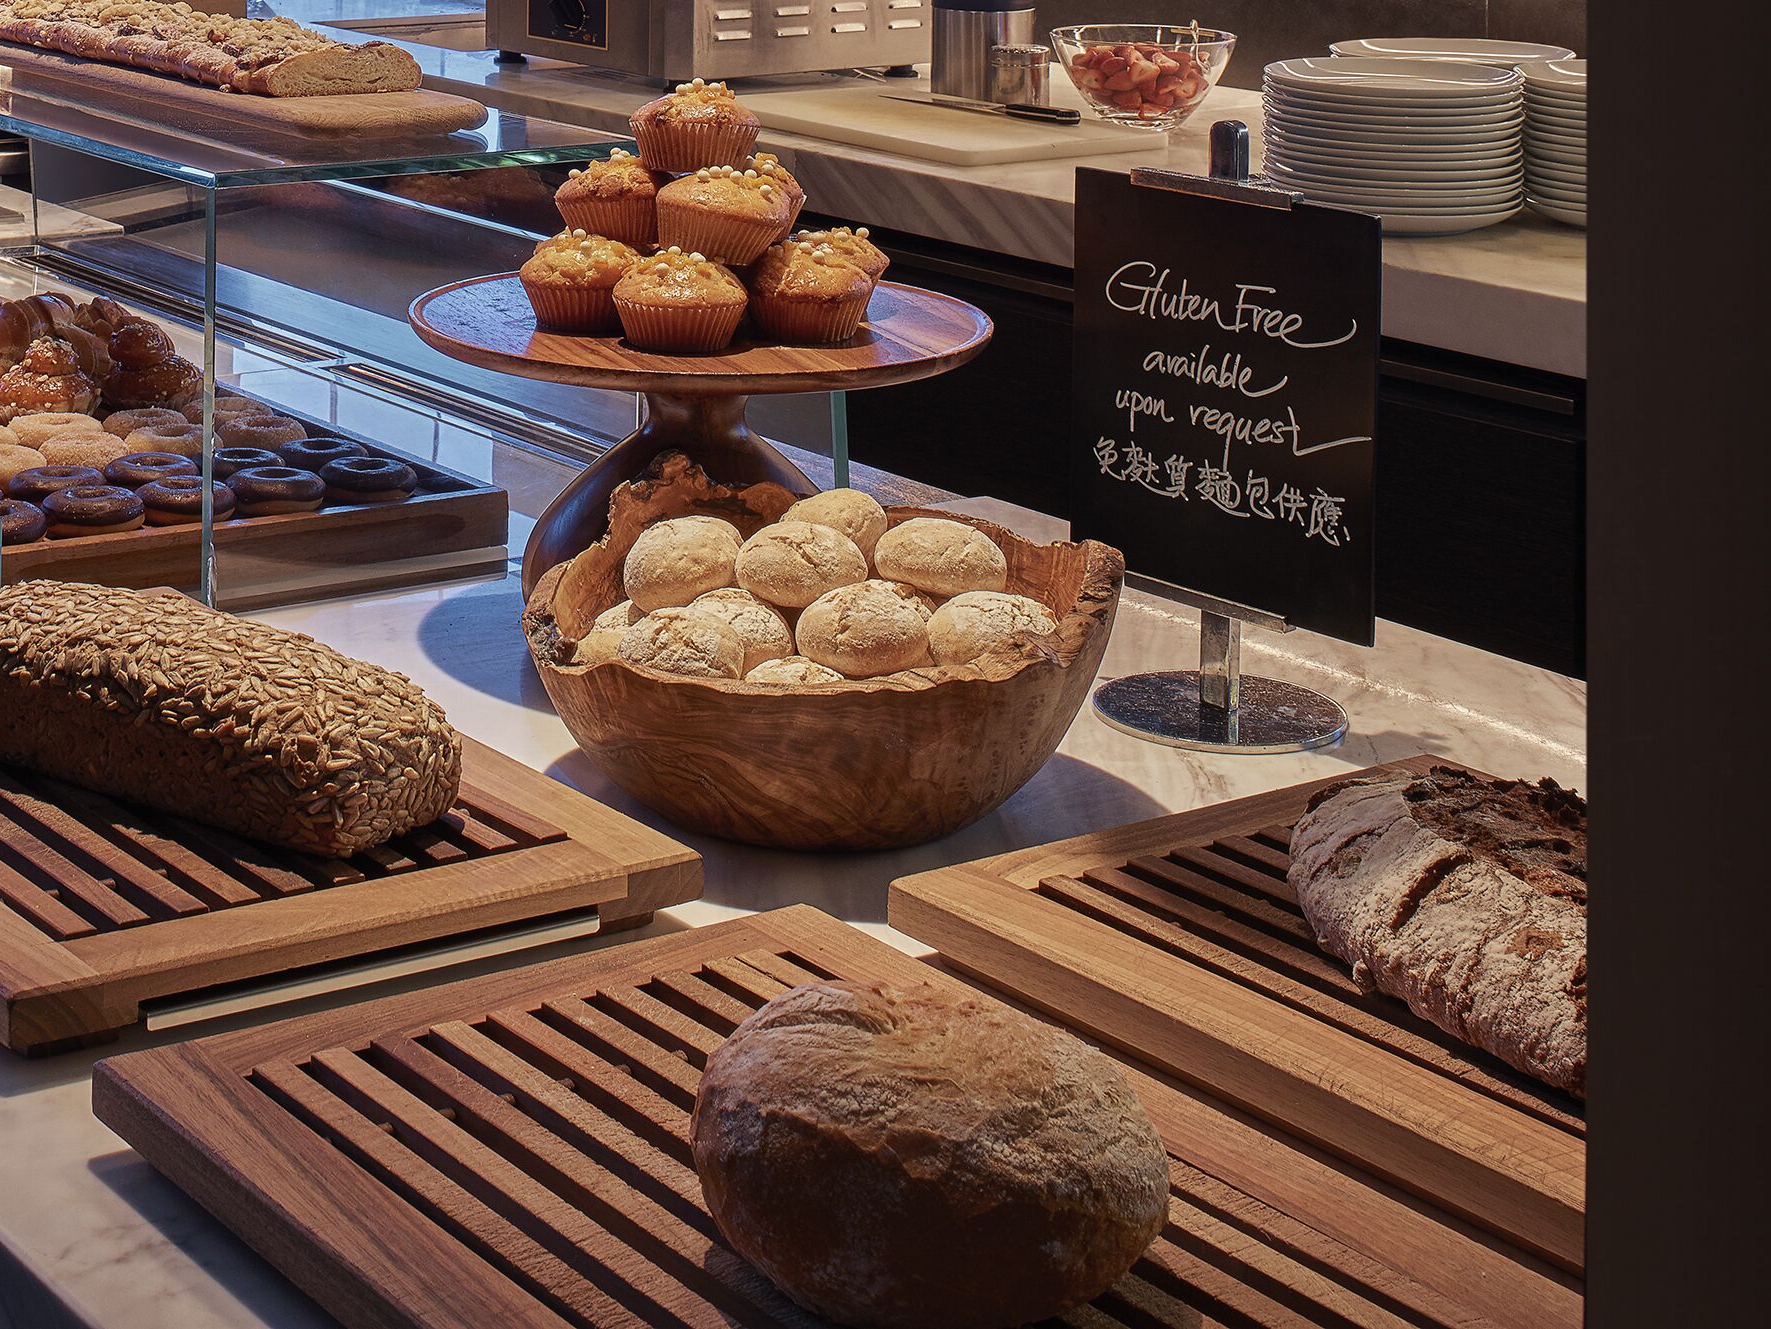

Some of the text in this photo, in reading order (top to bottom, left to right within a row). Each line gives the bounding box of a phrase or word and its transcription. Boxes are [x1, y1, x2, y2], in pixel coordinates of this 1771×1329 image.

[1105, 261, 1357, 347] Gluten Free
[1142, 345, 1288, 398] available
[1115, 390, 1372, 472] upon request
